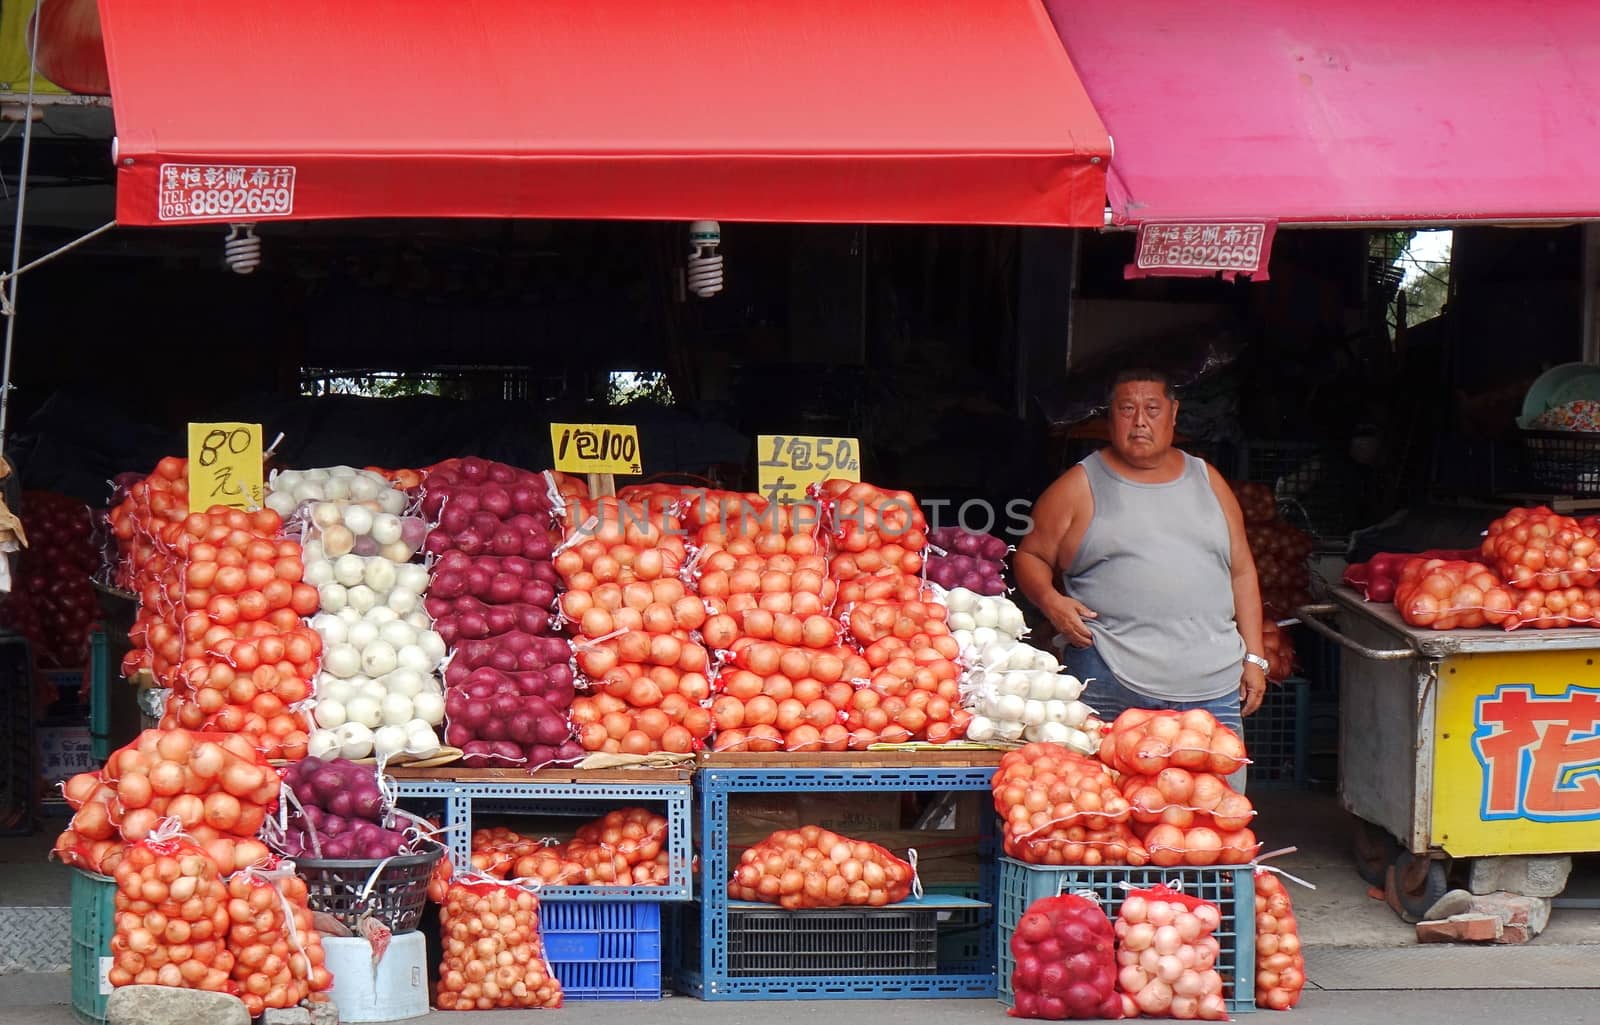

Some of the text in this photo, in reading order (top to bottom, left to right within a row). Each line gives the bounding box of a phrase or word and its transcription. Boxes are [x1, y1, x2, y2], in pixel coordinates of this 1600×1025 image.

[190, 188, 290, 215] 8892659
[1167, 245, 1257, 267] 8892659
[199, 428, 252, 467] 80
[210, 466, 241, 498] 元
